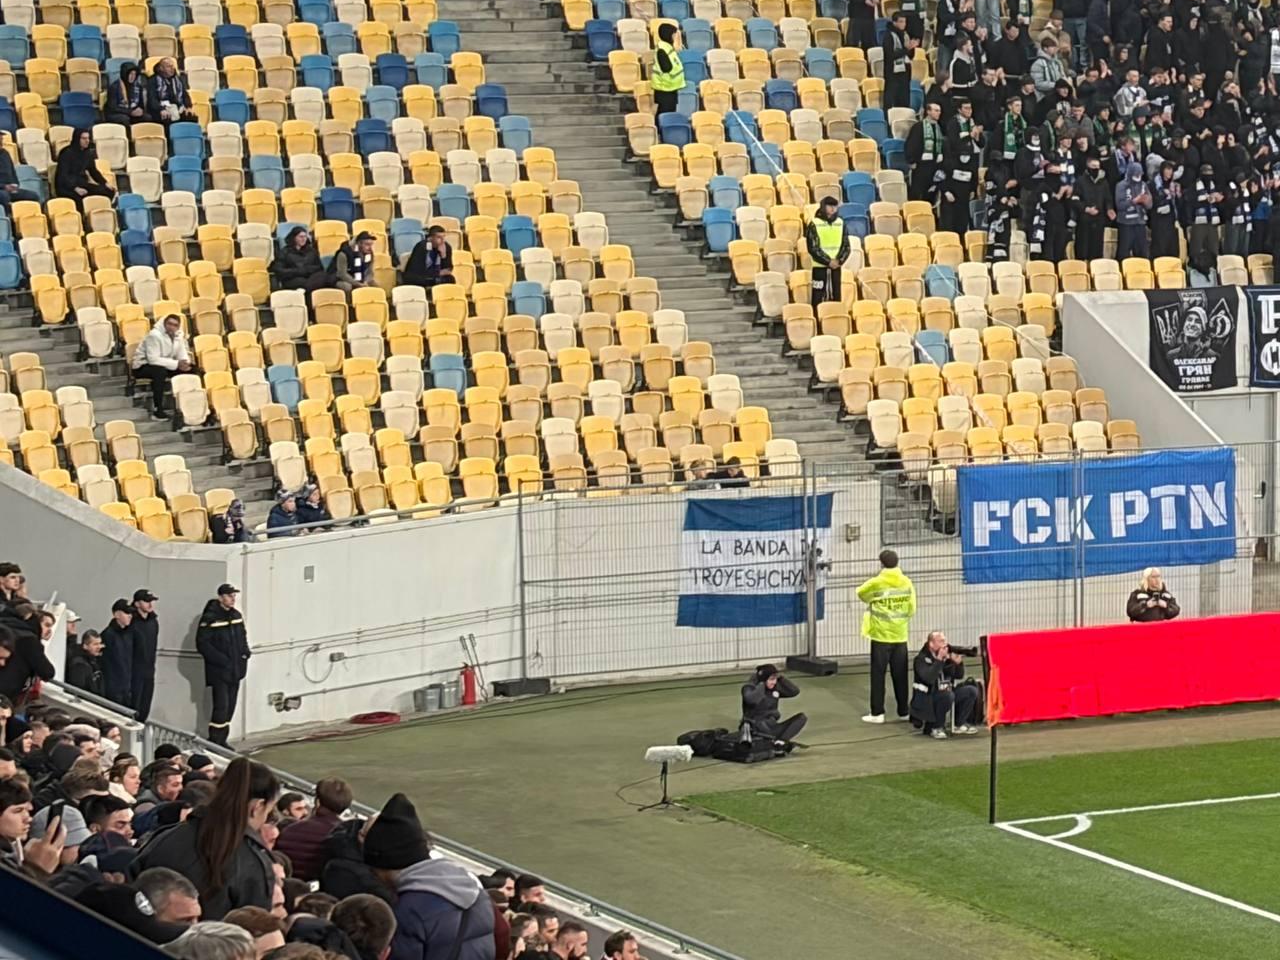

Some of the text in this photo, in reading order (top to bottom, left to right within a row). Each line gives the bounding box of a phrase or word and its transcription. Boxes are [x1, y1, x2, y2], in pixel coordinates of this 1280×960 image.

[973, 481, 1228, 547] FCK PTN
[701, 539, 722, 555] LA
[734, 539, 791, 556] BANDA
[689, 567, 811, 588] TROYESHCHYN
